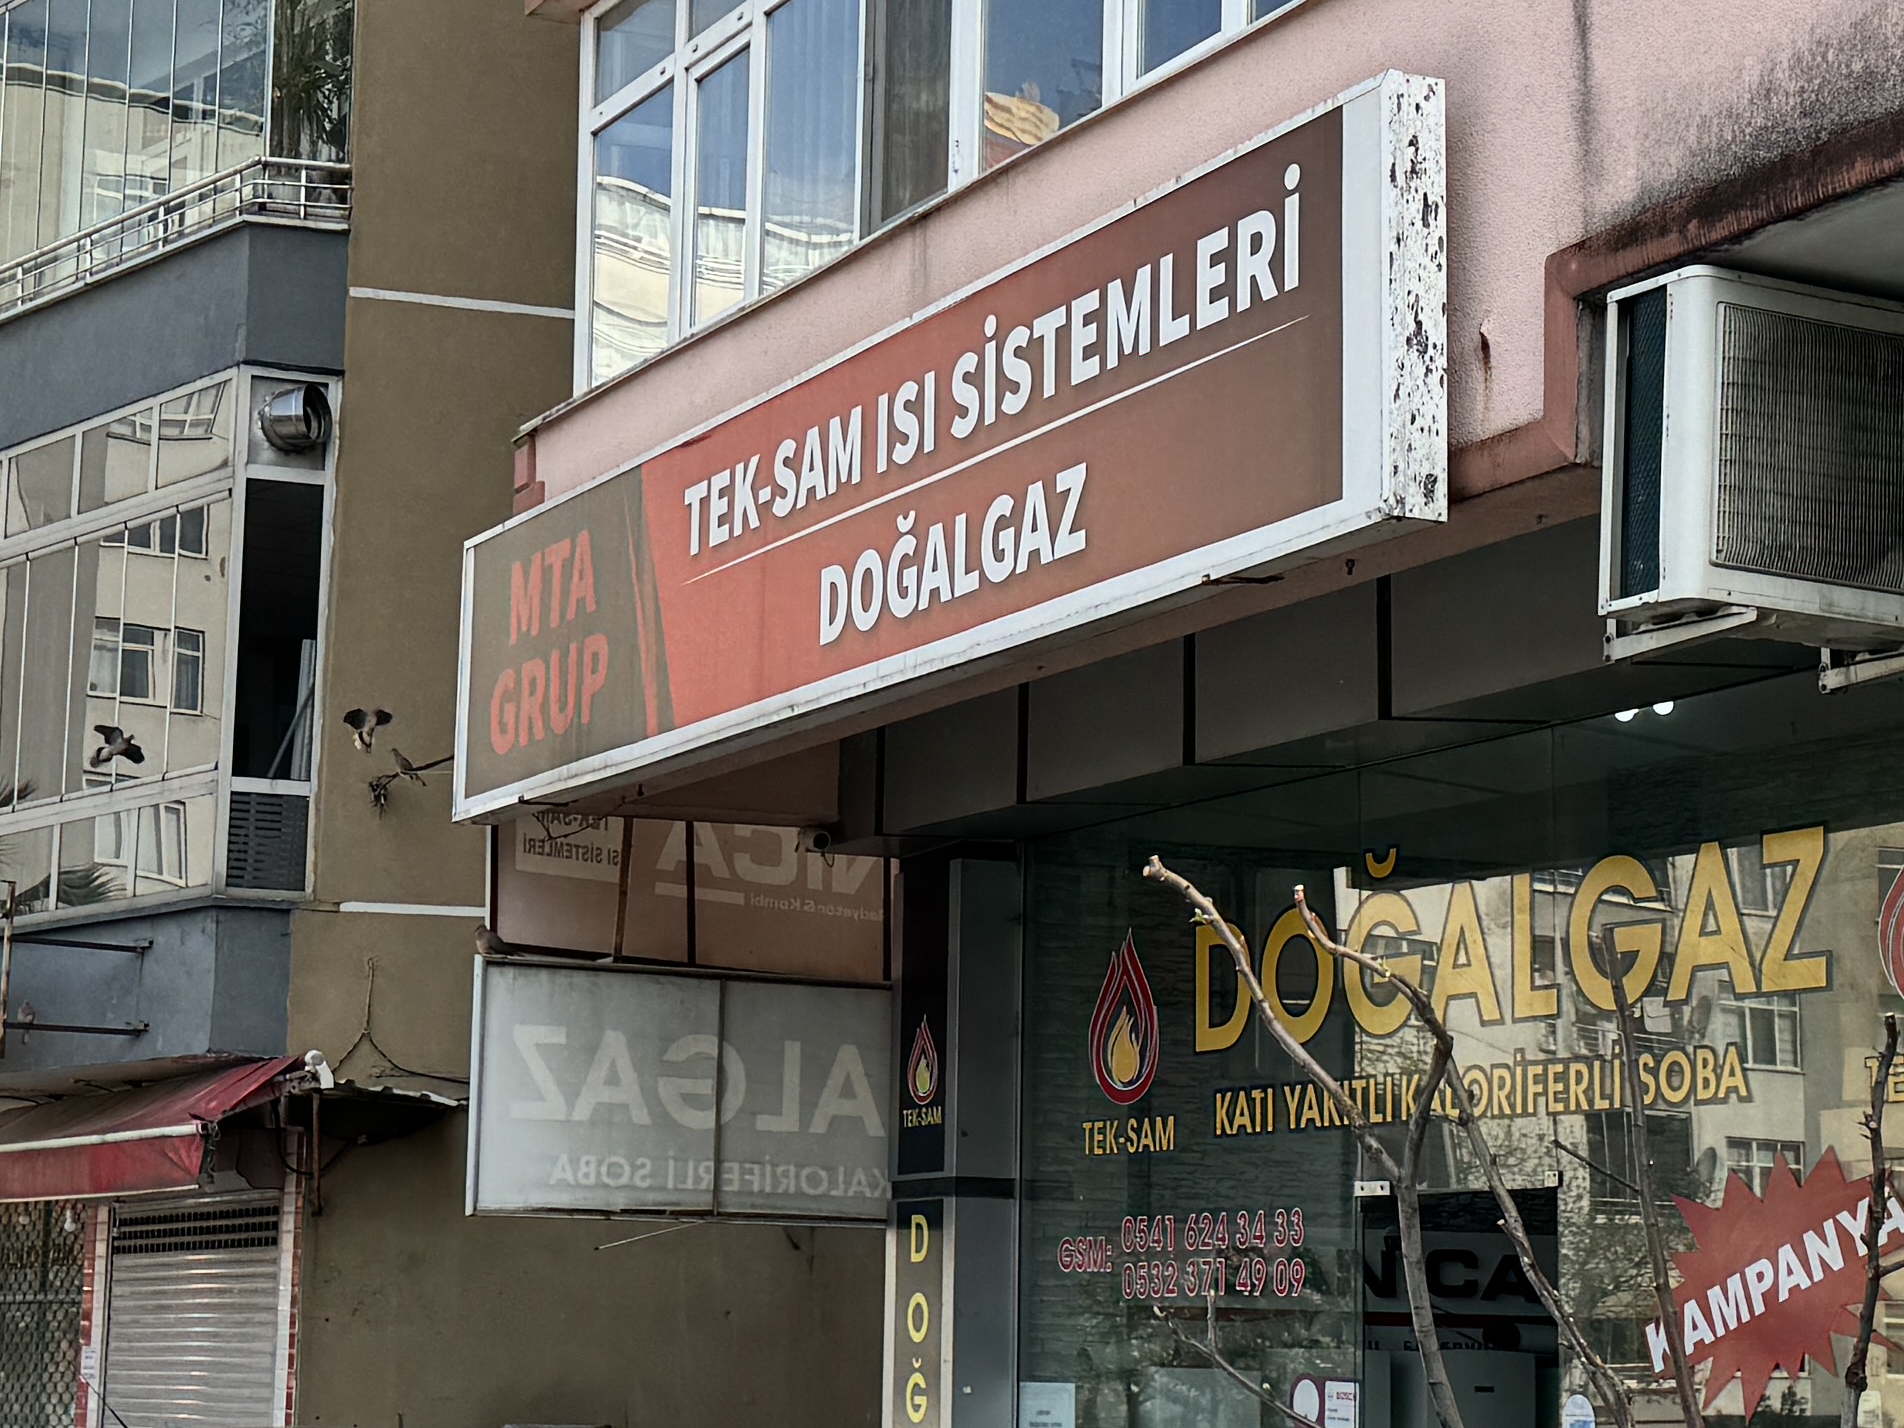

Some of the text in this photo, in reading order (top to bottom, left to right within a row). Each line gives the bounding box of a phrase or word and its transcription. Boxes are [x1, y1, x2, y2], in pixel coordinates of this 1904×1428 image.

[684, 164, 1303, 557] TEK-SAM ISI SİSTEMLERİ
[508, 530, 597, 647] MTA
[820, 462, 1088, 647] DOĞALGAZ
[490, 638, 607, 755] GRUP
[1195, 827, 1829, 1052] DOĞALGAZ
[903, 1106, 942, 1128] TEK-SAM
[1083, 1116, 1175, 1156] TEK-SAM
[1215, 1087, 1274, 1136] KATI
[1642, 1043, 1749, 1106] SOBA
[1057, 1237, 1114, 1273] GSM:
[1122, 1207, 1305, 1254] 0541 624 34 33
[1122, 1257, 1306, 1300] 0532 371 49 09
